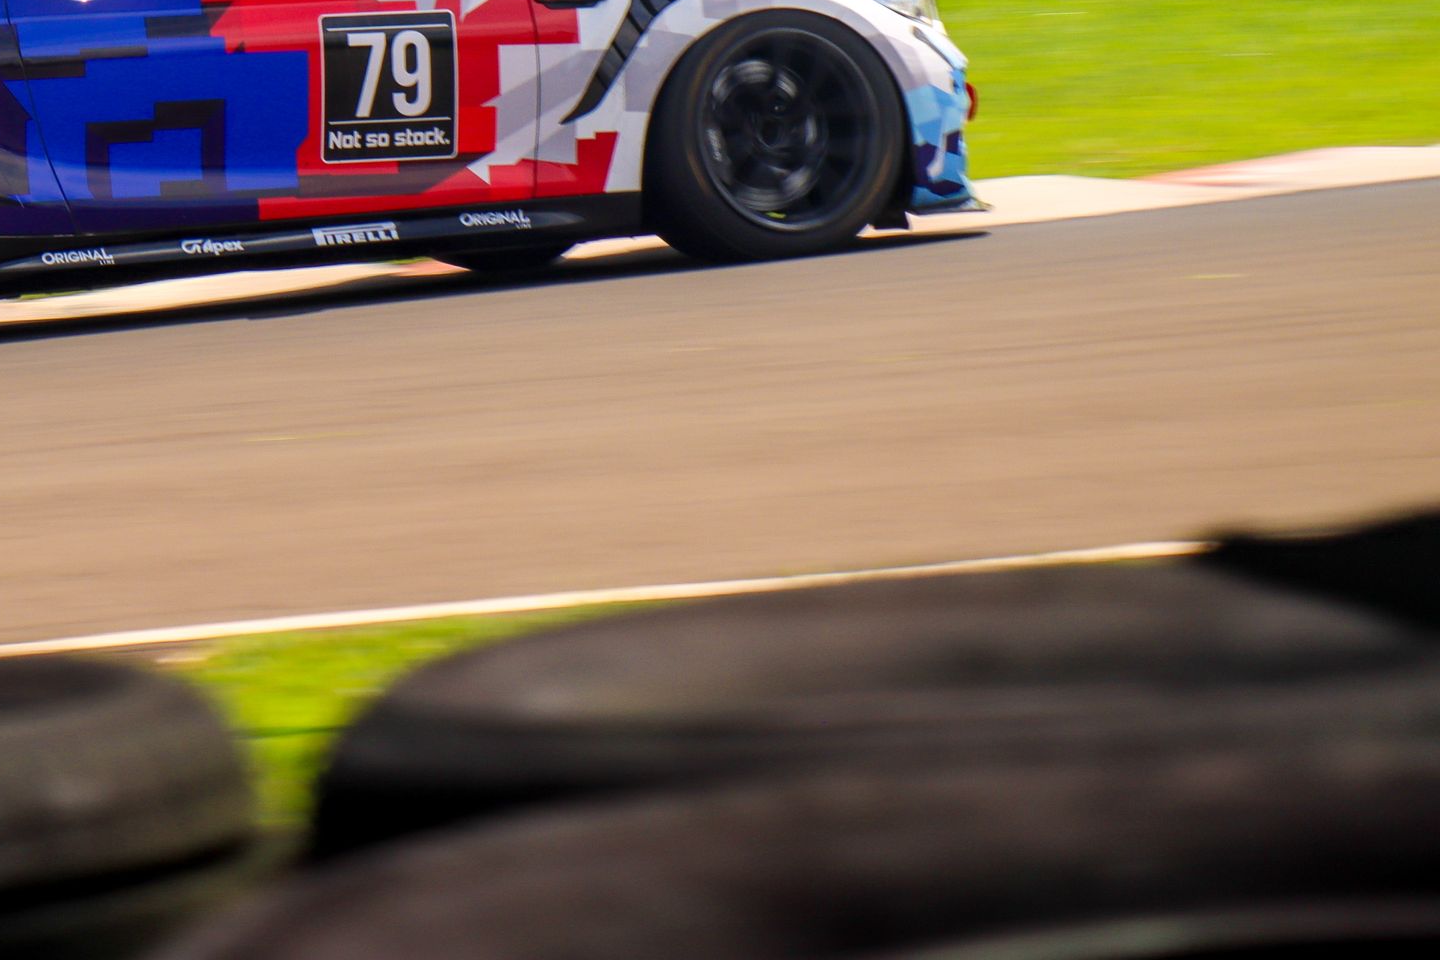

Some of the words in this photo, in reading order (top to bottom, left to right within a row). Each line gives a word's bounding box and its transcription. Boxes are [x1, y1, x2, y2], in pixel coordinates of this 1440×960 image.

[347, 30, 432, 118] 79
[328, 128, 362, 150] Not
[365, 132, 390, 148] so
[394, 126, 451, 147] stock.
[459, 208, 531, 227] ORIGINAL
[311, 222, 400, 246] PIRELLI
[41, 247, 113, 265] ORIGINAL
